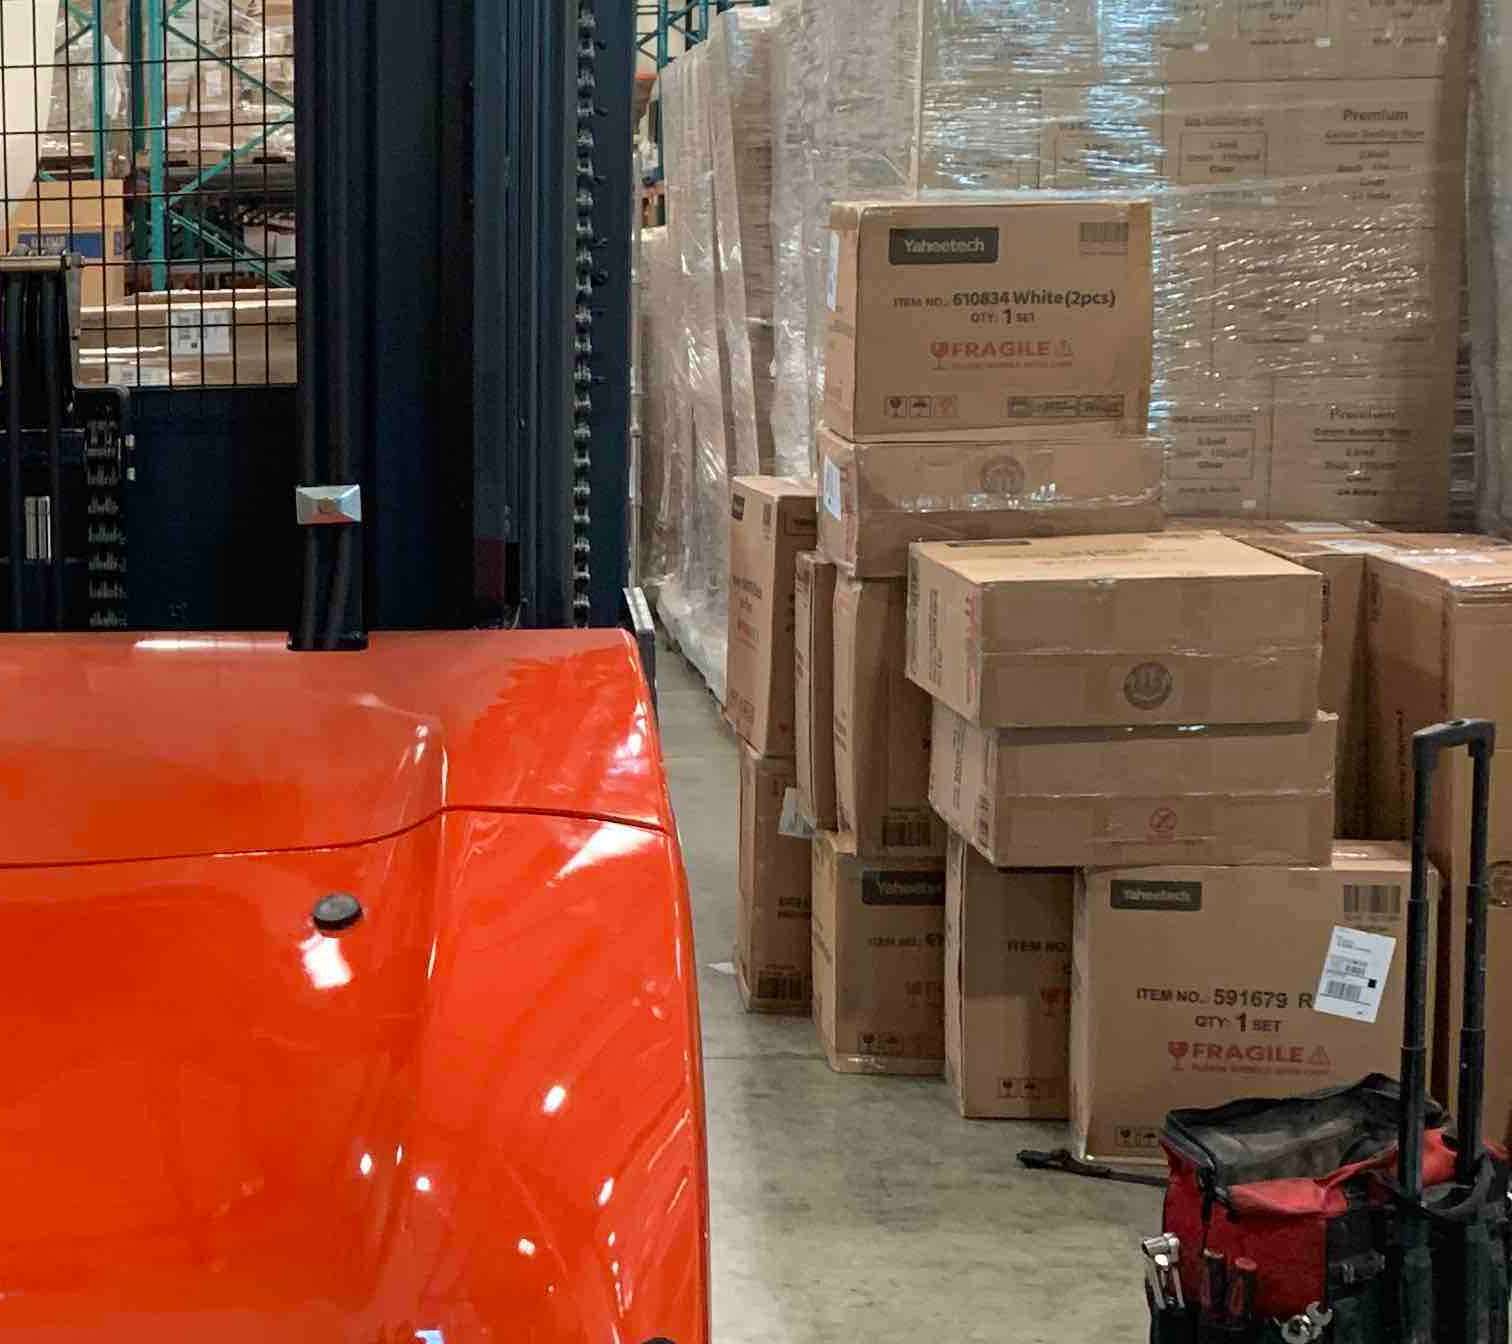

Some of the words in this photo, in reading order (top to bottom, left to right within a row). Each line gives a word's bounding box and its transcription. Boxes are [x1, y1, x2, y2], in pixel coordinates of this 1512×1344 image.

[1343, 109, 1409, 121] Premium
[904, 237, 985, 254] Yaheetech
[893, 296, 922, 307] ITEM
[952, 290, 1010, 306] 610834
[1003, 309, 1012, 324] 1
[1016, 312, 1035, 324] SET
[952, 340, 1050, 357] FRAGILE
[1007, 940, 1041, 953] ITEM
[1136, 987, 1173, 1002] ITEM
[1213, 990, 1289, 1008] 591679
[1237, 1012, 1247, 1033] 1
[1252, 1020, 1282, 1033] SET
[1191, 1042, 1304, 1064] FRAGILE
